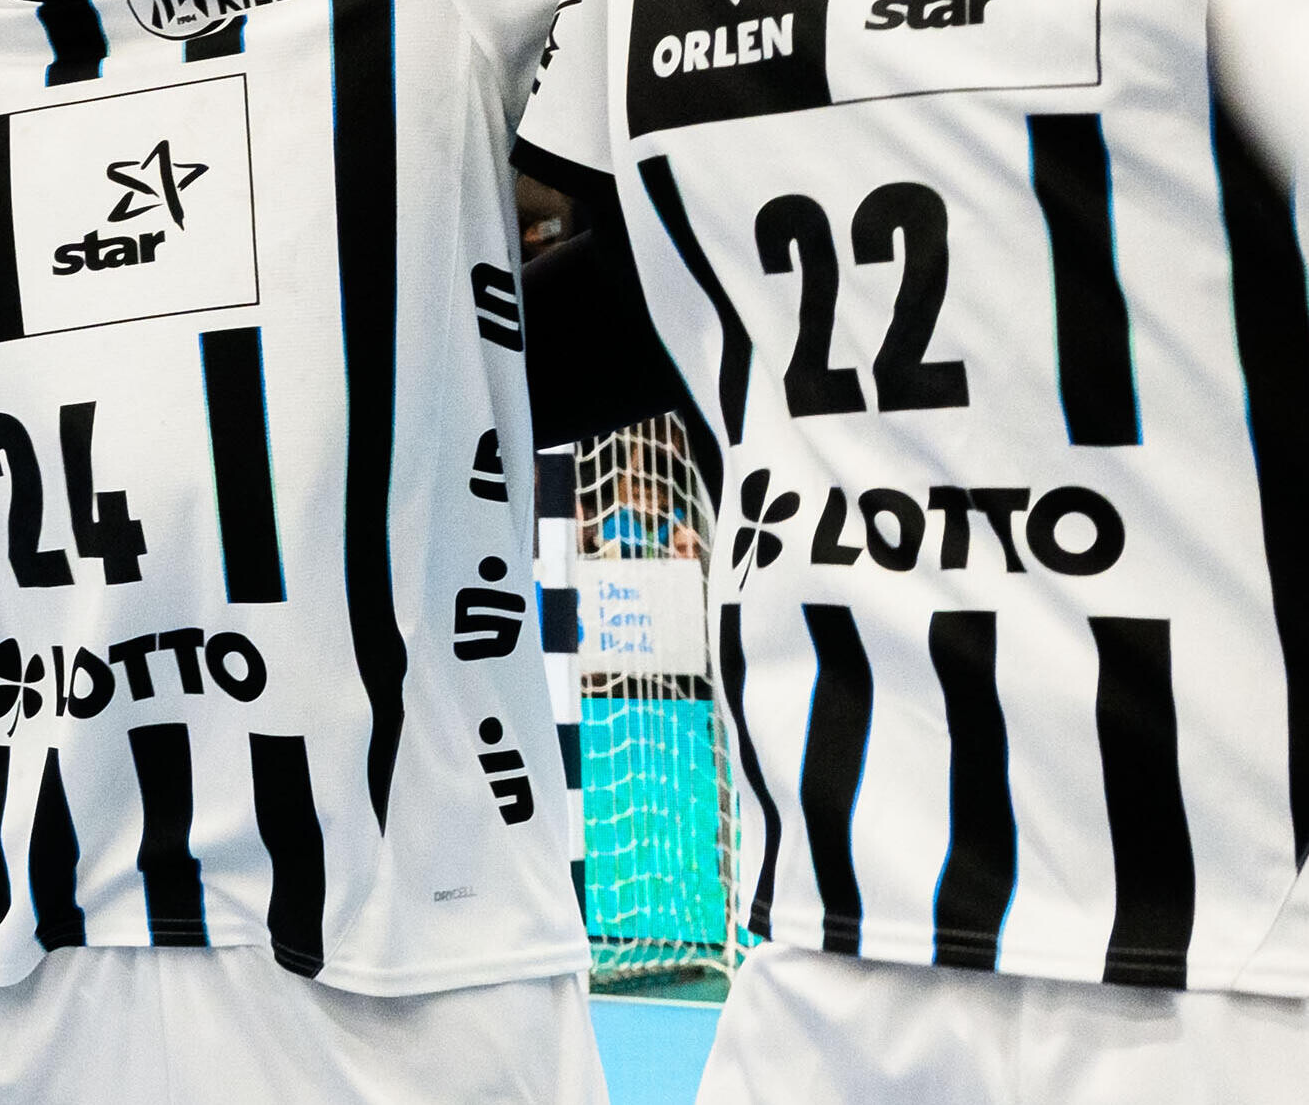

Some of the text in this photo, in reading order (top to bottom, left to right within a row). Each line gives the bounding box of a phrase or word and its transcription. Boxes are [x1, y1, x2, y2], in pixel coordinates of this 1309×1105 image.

[652, 11, 793, 78] ORLEN
[52, 229, 166, 277] star
[754, 182, 970, 418] 22
[811, 485, 1125, 576] LOTTO
[56, 627, 267, 720] LOTTO
